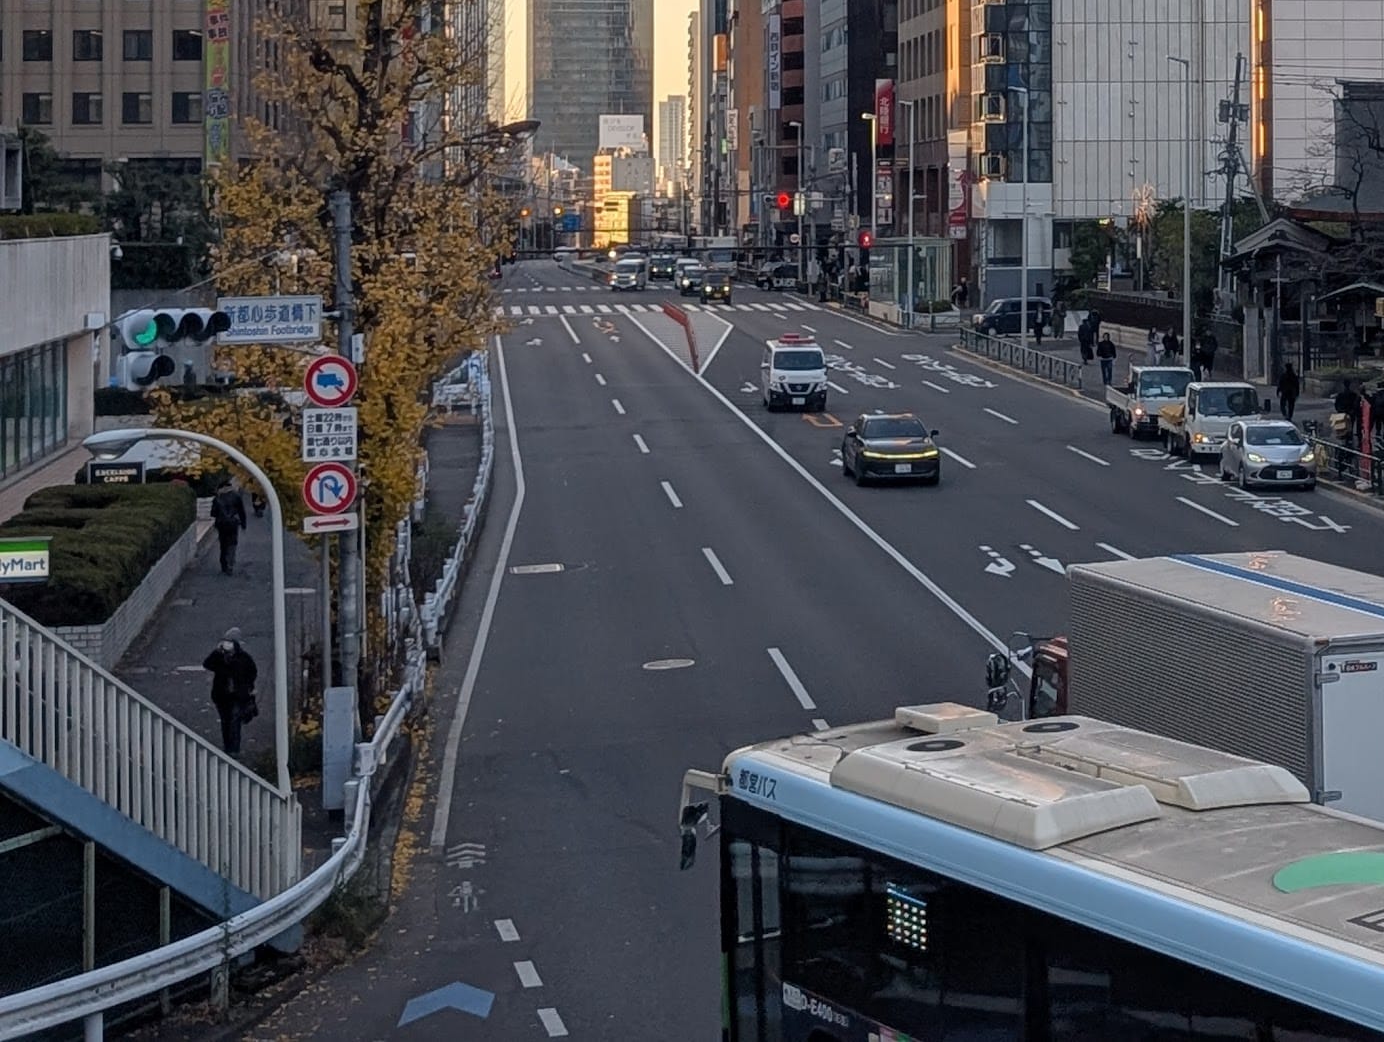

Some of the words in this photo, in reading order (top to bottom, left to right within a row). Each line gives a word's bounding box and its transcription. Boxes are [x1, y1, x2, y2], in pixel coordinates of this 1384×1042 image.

[224, 303, 317, 323] 新都心歩道橋下
[271, 324, 314, 335] Footbridge
[739, 769, 776, 800] 都営バス
